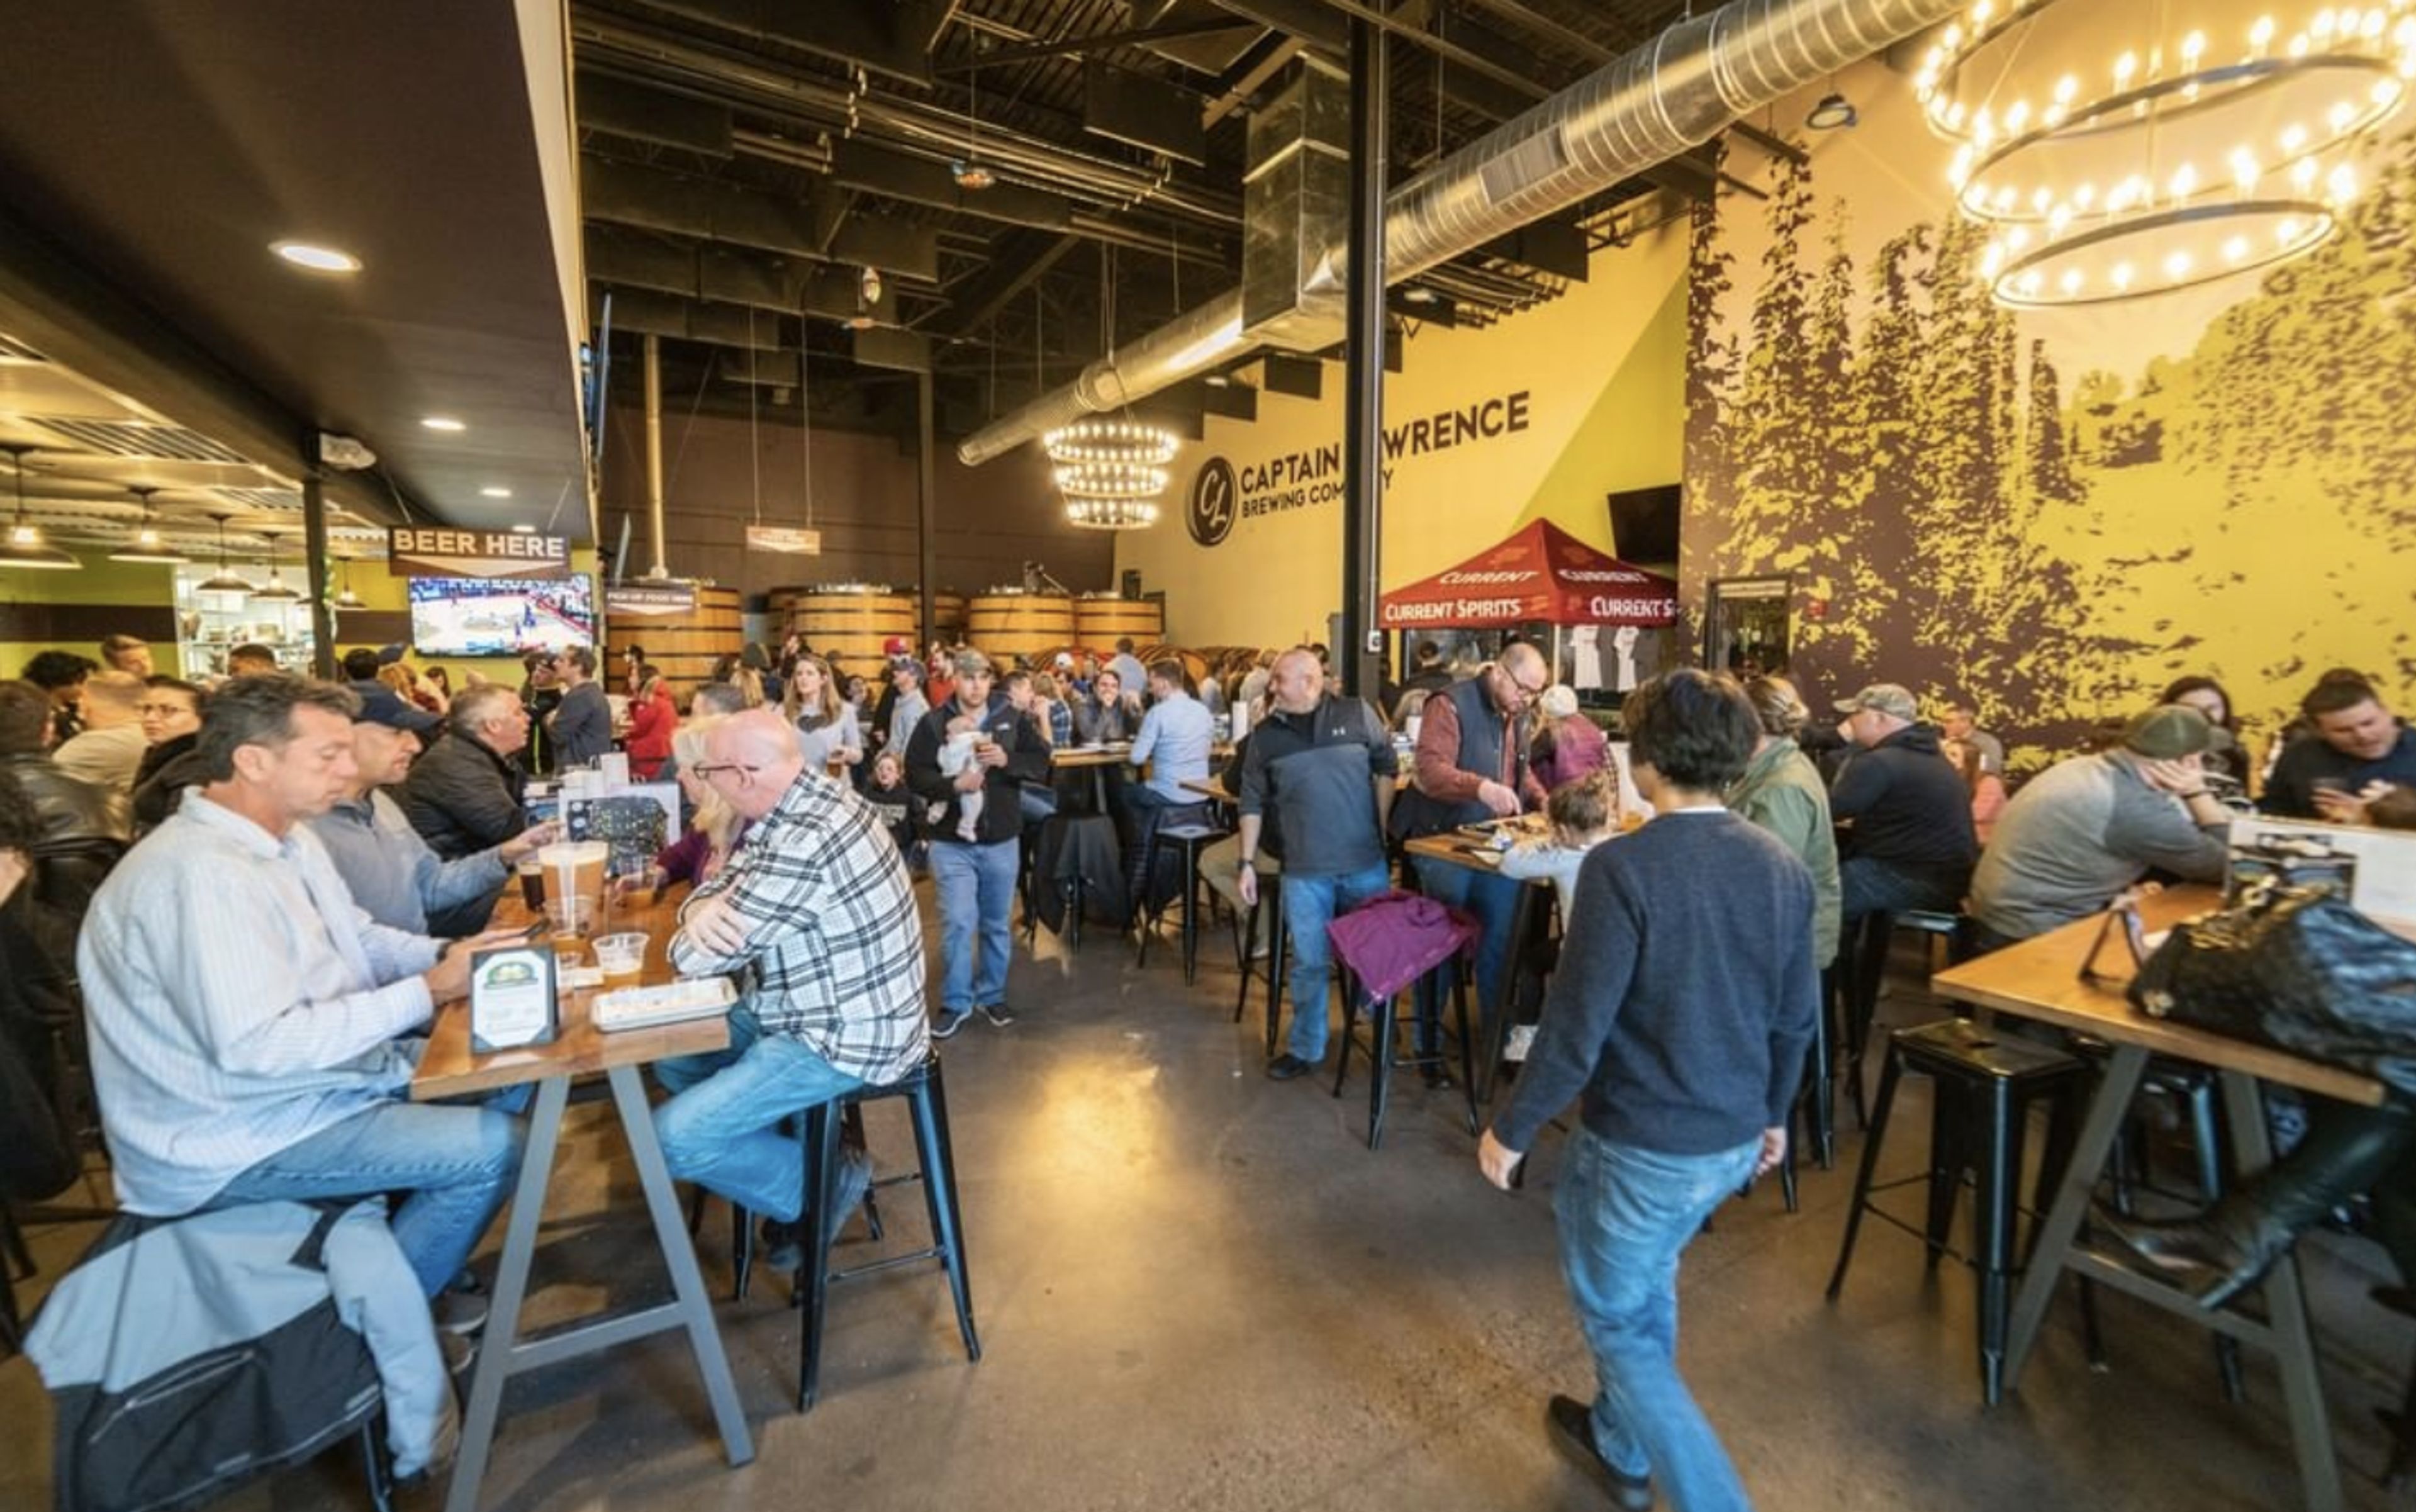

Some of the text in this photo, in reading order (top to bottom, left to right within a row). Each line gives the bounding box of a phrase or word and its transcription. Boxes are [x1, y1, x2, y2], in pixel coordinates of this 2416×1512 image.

[1241, 390, 1530, 493] CAPTAIN WRENCE
[1243, 488, 1306, 518] BREWING
[393, 530, 564, 557] BEER HERE
[1440, 571, 1540, 585] CURRENT
[1385, 598, 1522, 622] CURRENT SPIRITS
[1591, 596, 1662, 617] CURRENT
